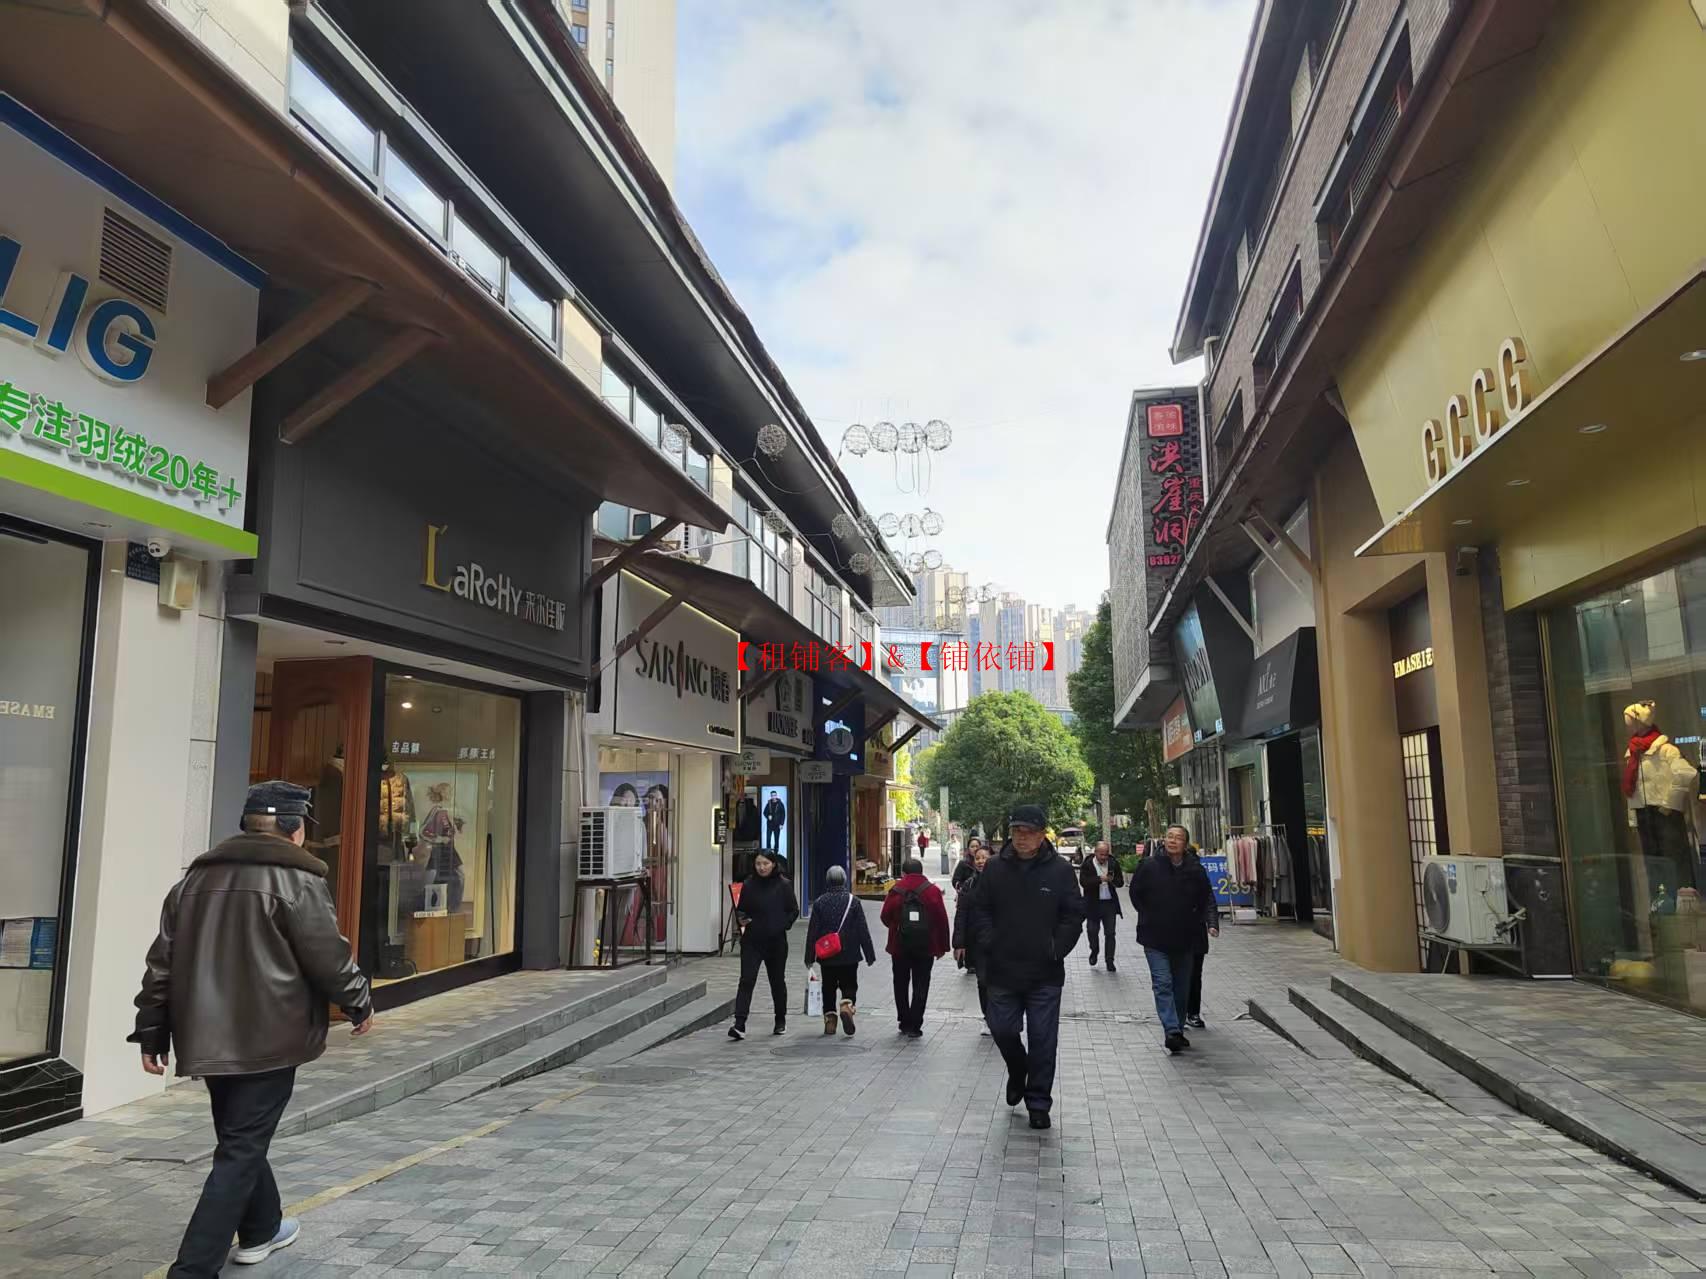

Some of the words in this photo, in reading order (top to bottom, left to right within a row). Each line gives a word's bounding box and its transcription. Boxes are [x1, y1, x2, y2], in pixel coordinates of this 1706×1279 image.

[1422, 336, 1532, 488] GCCG
[1147, 441, 1188, 546] 洪崖洞
